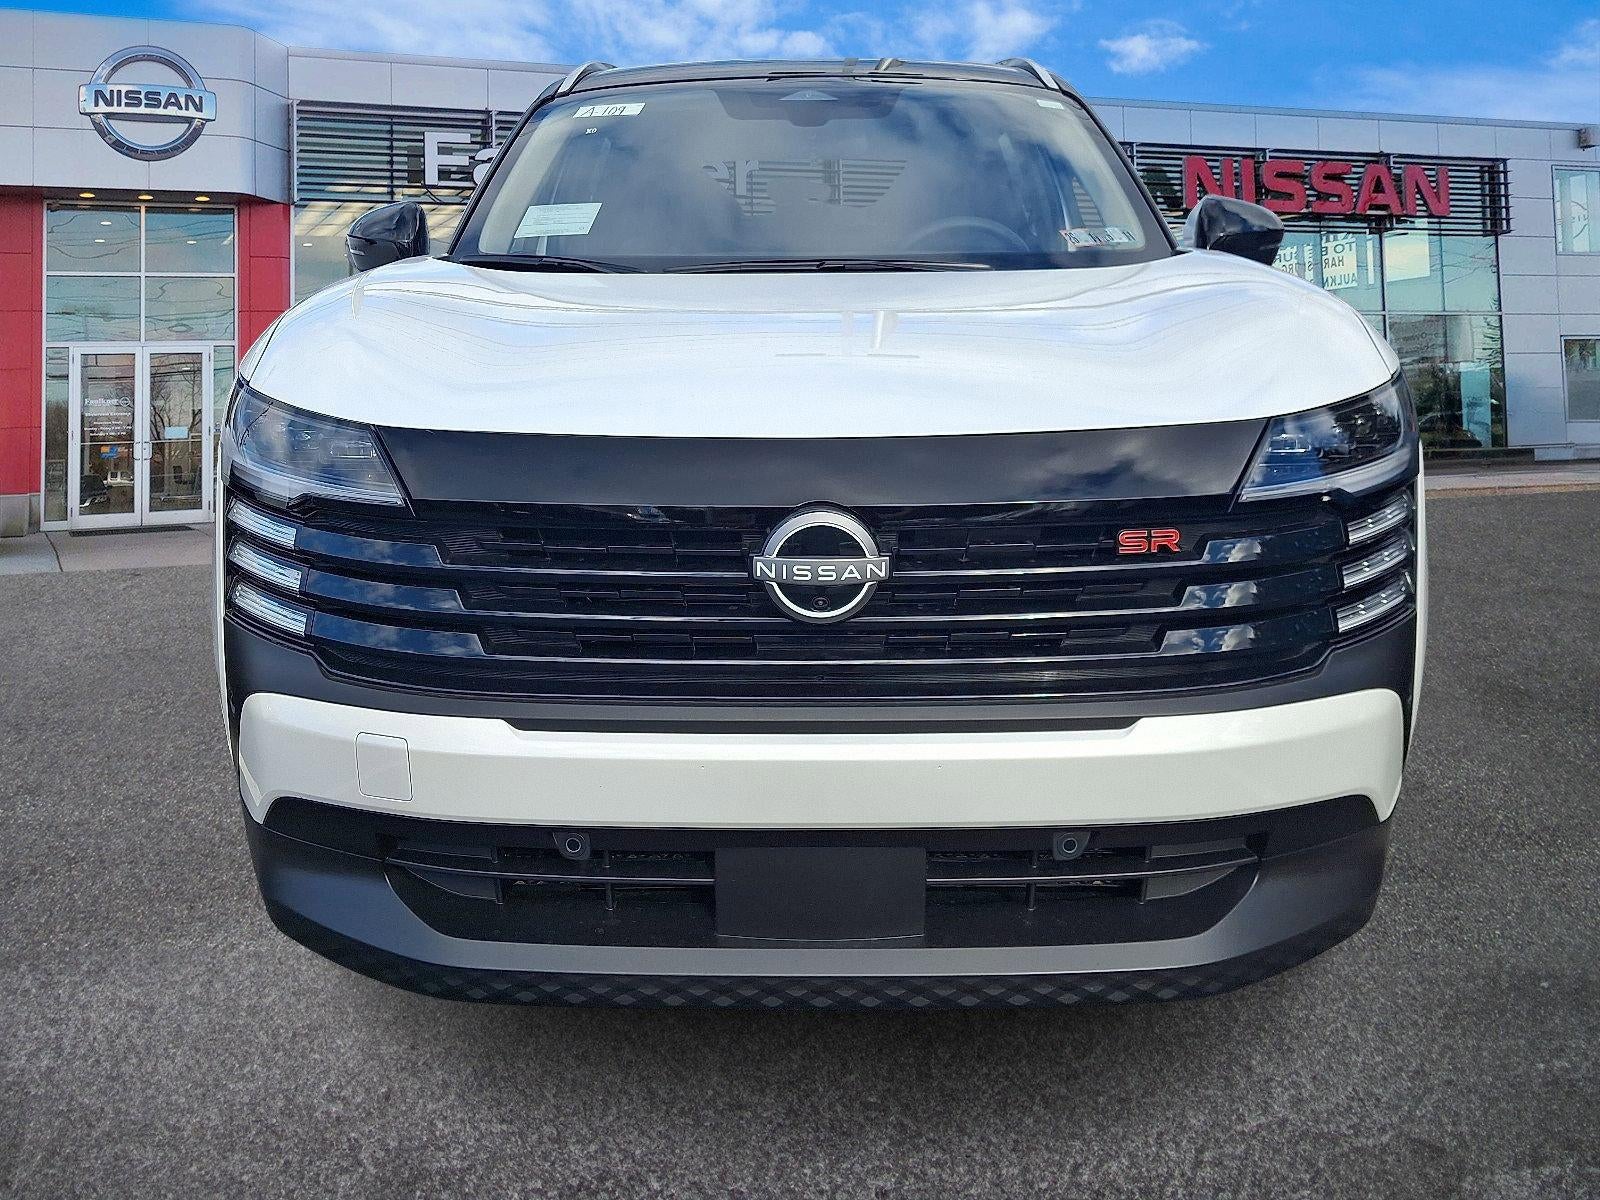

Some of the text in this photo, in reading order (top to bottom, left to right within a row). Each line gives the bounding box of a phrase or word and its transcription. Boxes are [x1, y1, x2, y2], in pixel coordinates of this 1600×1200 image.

[93, 89, 203, 113] NISSAN
[1183, 155, 1450, 217] NISSAN
[1118, 528, 1181, 554] SR
[756, 561, 886, 581] NISSAN
